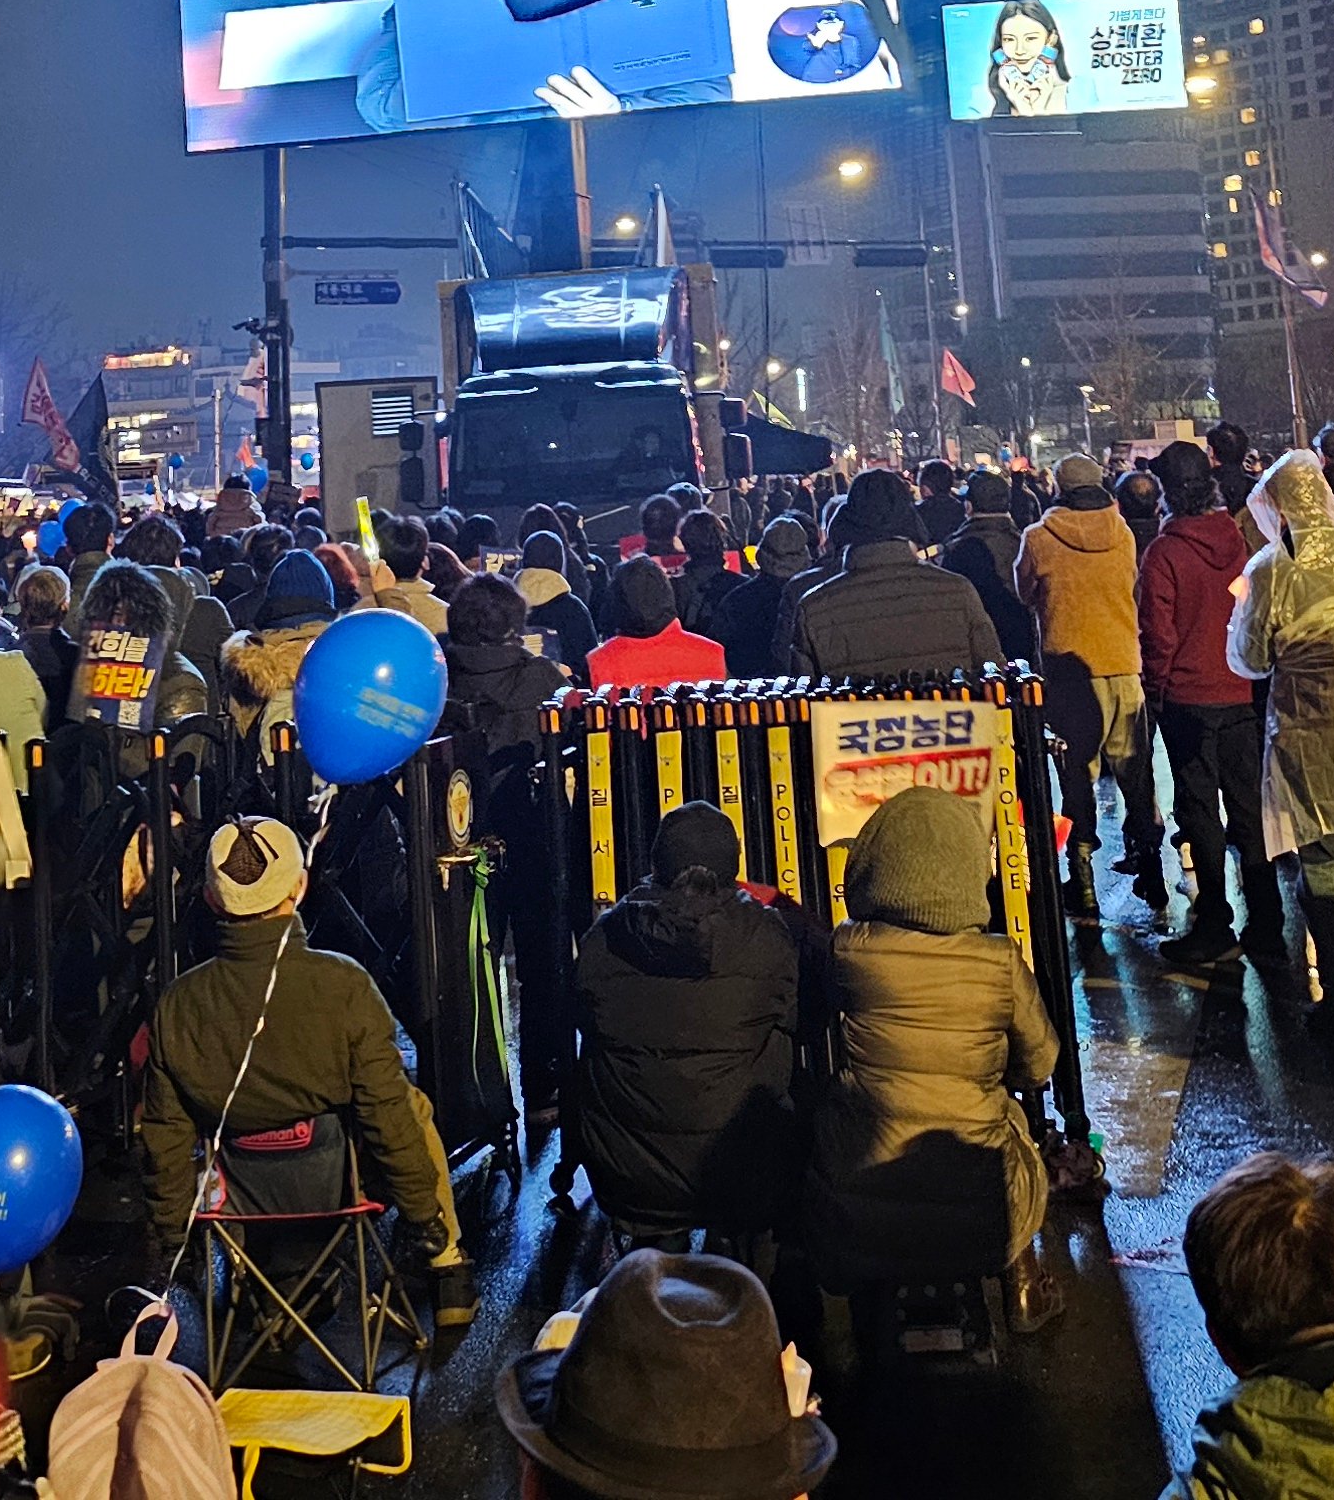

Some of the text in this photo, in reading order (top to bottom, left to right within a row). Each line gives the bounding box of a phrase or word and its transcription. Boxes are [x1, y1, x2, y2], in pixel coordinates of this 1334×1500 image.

[1090, 23, 1166, 50] 상쾌환
[1091, 50, 1163, 69] BOOSTER
[1122, 68, 1162, 84] ZERO
[838, 710, 974, 753] 국정농단
[916, 757, 988, 792] OUT!
[999, 767, 1022, 890] POLICE
